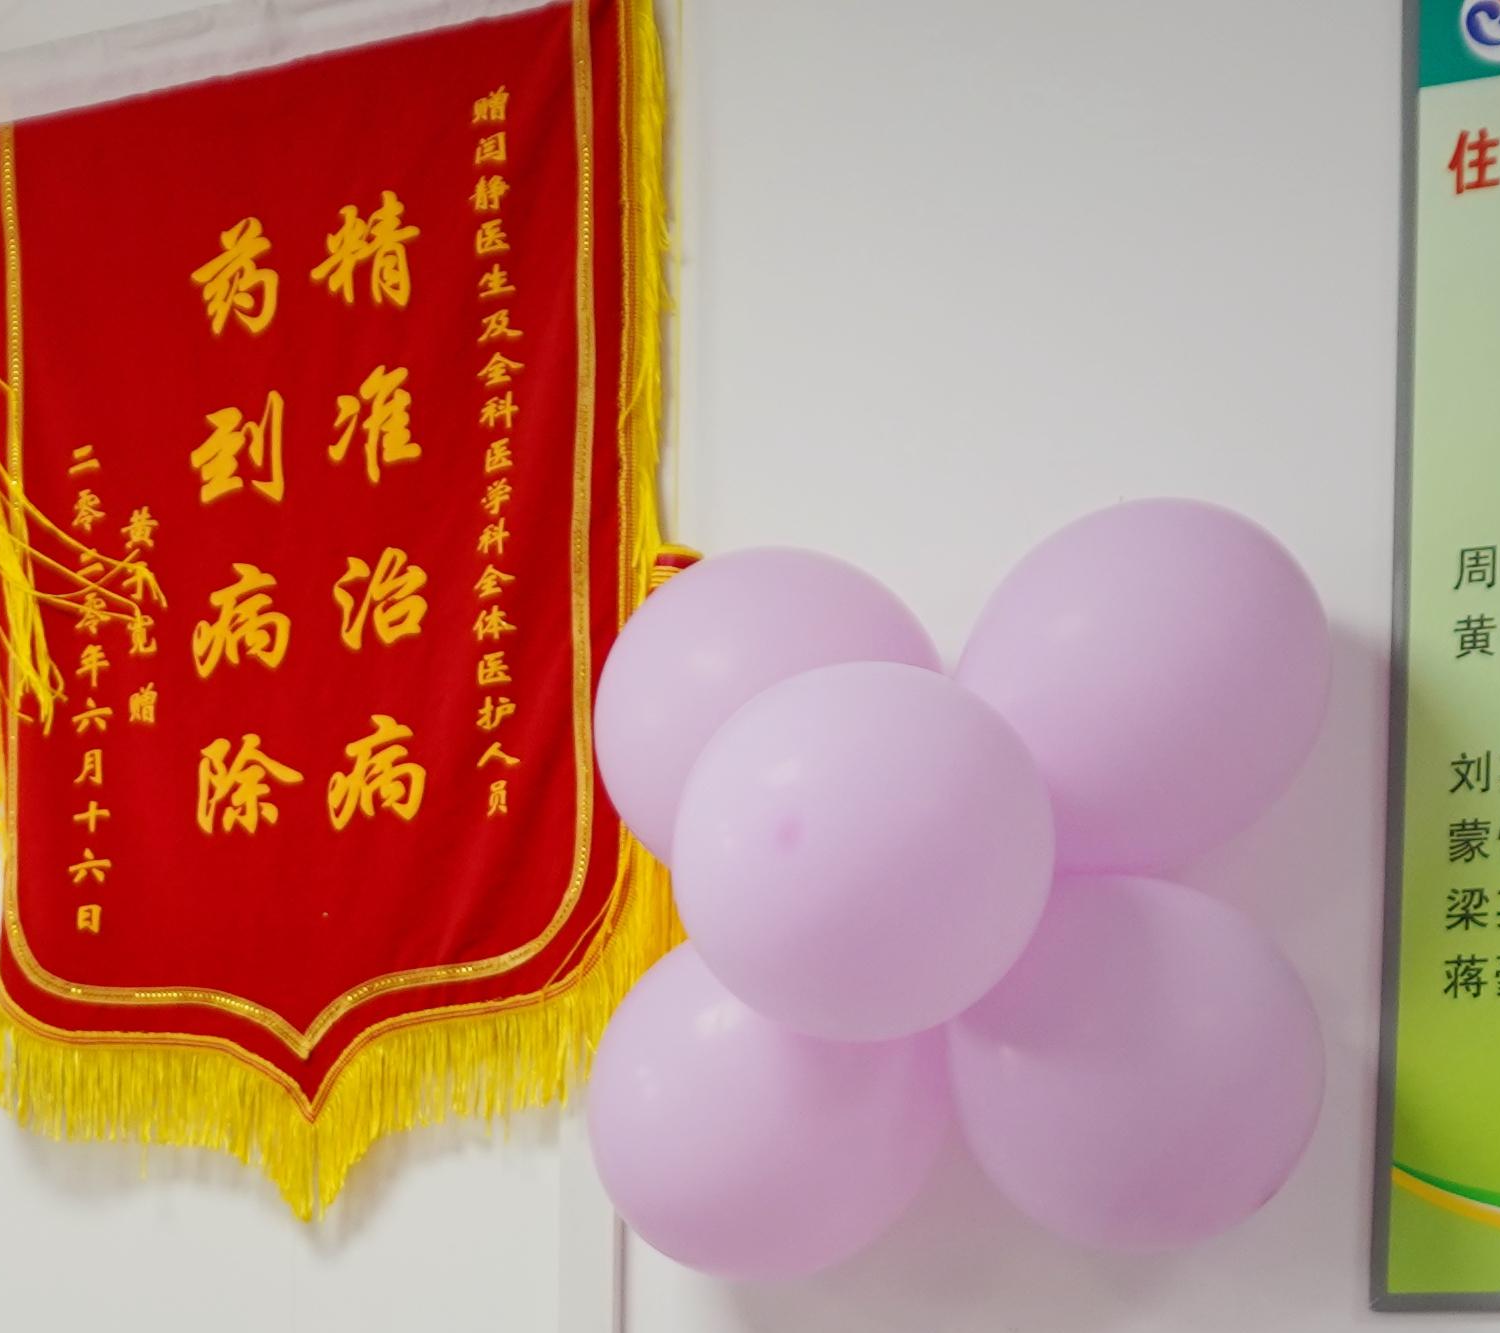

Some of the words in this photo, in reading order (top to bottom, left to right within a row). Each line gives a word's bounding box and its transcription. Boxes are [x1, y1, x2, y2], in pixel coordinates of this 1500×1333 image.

[189, 215, 304, 835] 药到病除
[309, 189, 429, 825] 精准治病
